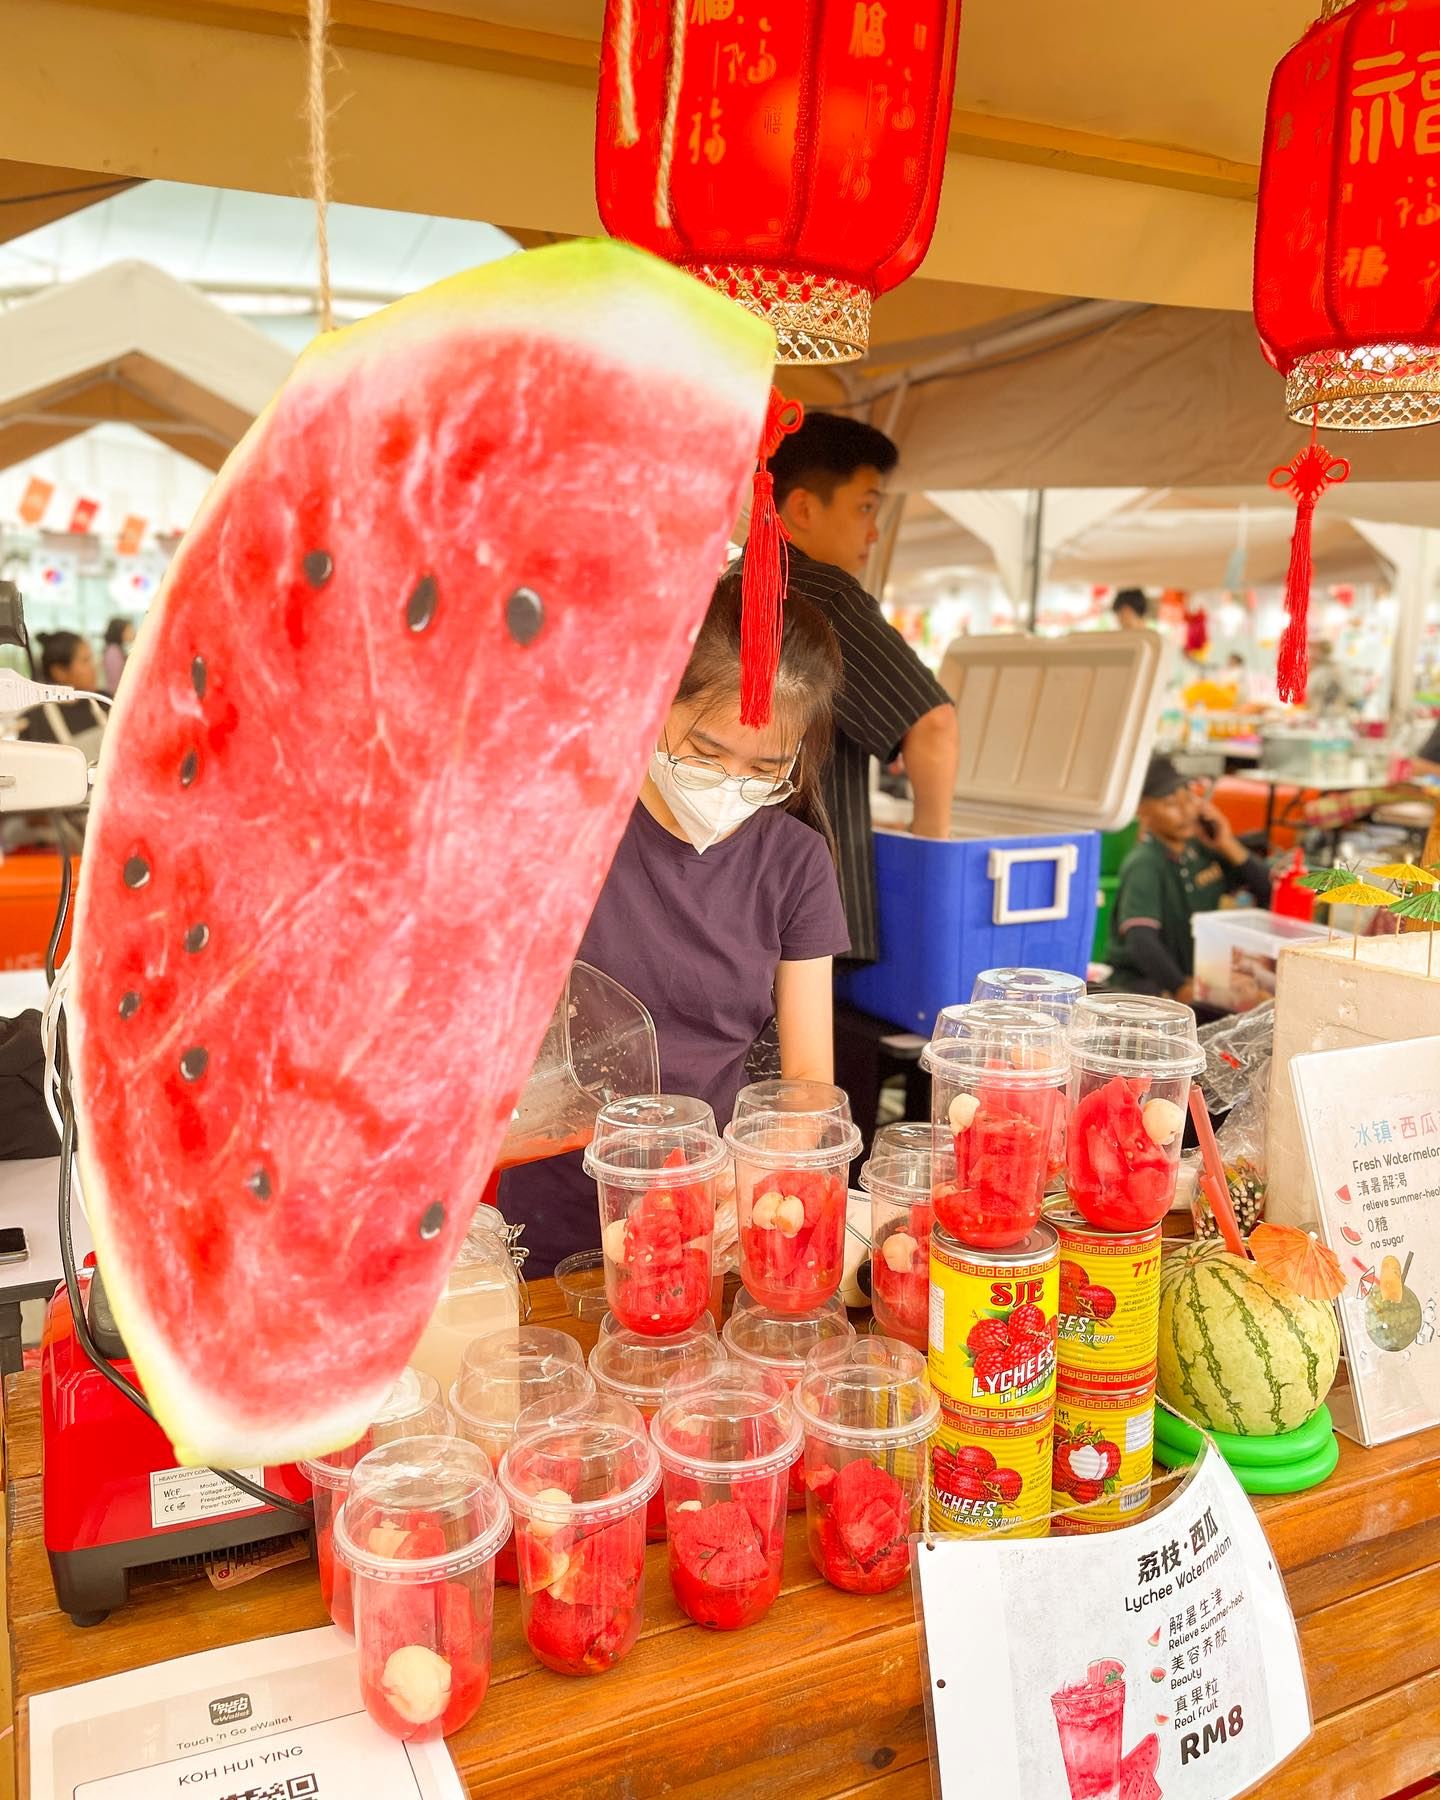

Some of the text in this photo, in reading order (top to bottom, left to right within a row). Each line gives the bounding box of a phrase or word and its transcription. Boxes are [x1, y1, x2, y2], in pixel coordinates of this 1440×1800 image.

[1350, 1111, 1440, 1149] 冰镇·西瓜
[1352, 1156, 1382, 1173] Fresh
[1362, 1196, 1389, 1212] relieve
[1370, 1234, 1405, 1250] no sugar
[990, 1277, 1044, 1307] SJE
[1079, 1333, 1115, 1344] SYRUP
[972, 1339, 1054, 1398] LYCHEES
[1000, 1392, 1011, 1404] IN
[1015, 1373, 1043, 1399] HEAVY
[178, 1471, 194, 1479] DUTY
[951, 1514, 985, 1528] HEAVY
[986, 1515, 1022, 1528] SYRUP
[1137, 1505, 1219, 1585] 荔枝·西瓜
[1125, 1584, 1173, 1613] Lychee
[1169, 1588, 1223, 1637] 解暑生津
[1168, 1625, 1200, 1651] Relieve
[1171, 1626, 1228, 1675] 美容养颜
[1170, 1667, 1202, 1690] Beauty
[210, 1697, 249, 1712] Touch
[1174, 1677, 1219, 1716] 真果粒
[177, 1736, 214, 1750] Touch
[230, 1727, 247, 1737] Go
[250, 1715, 293, 1732] eWallet
[1174, 1710, 1196, 1730] Real
[1180, 1704, 1244, 1766] RM8
[178, 1746, 303, 1786] KOH HUI YING
